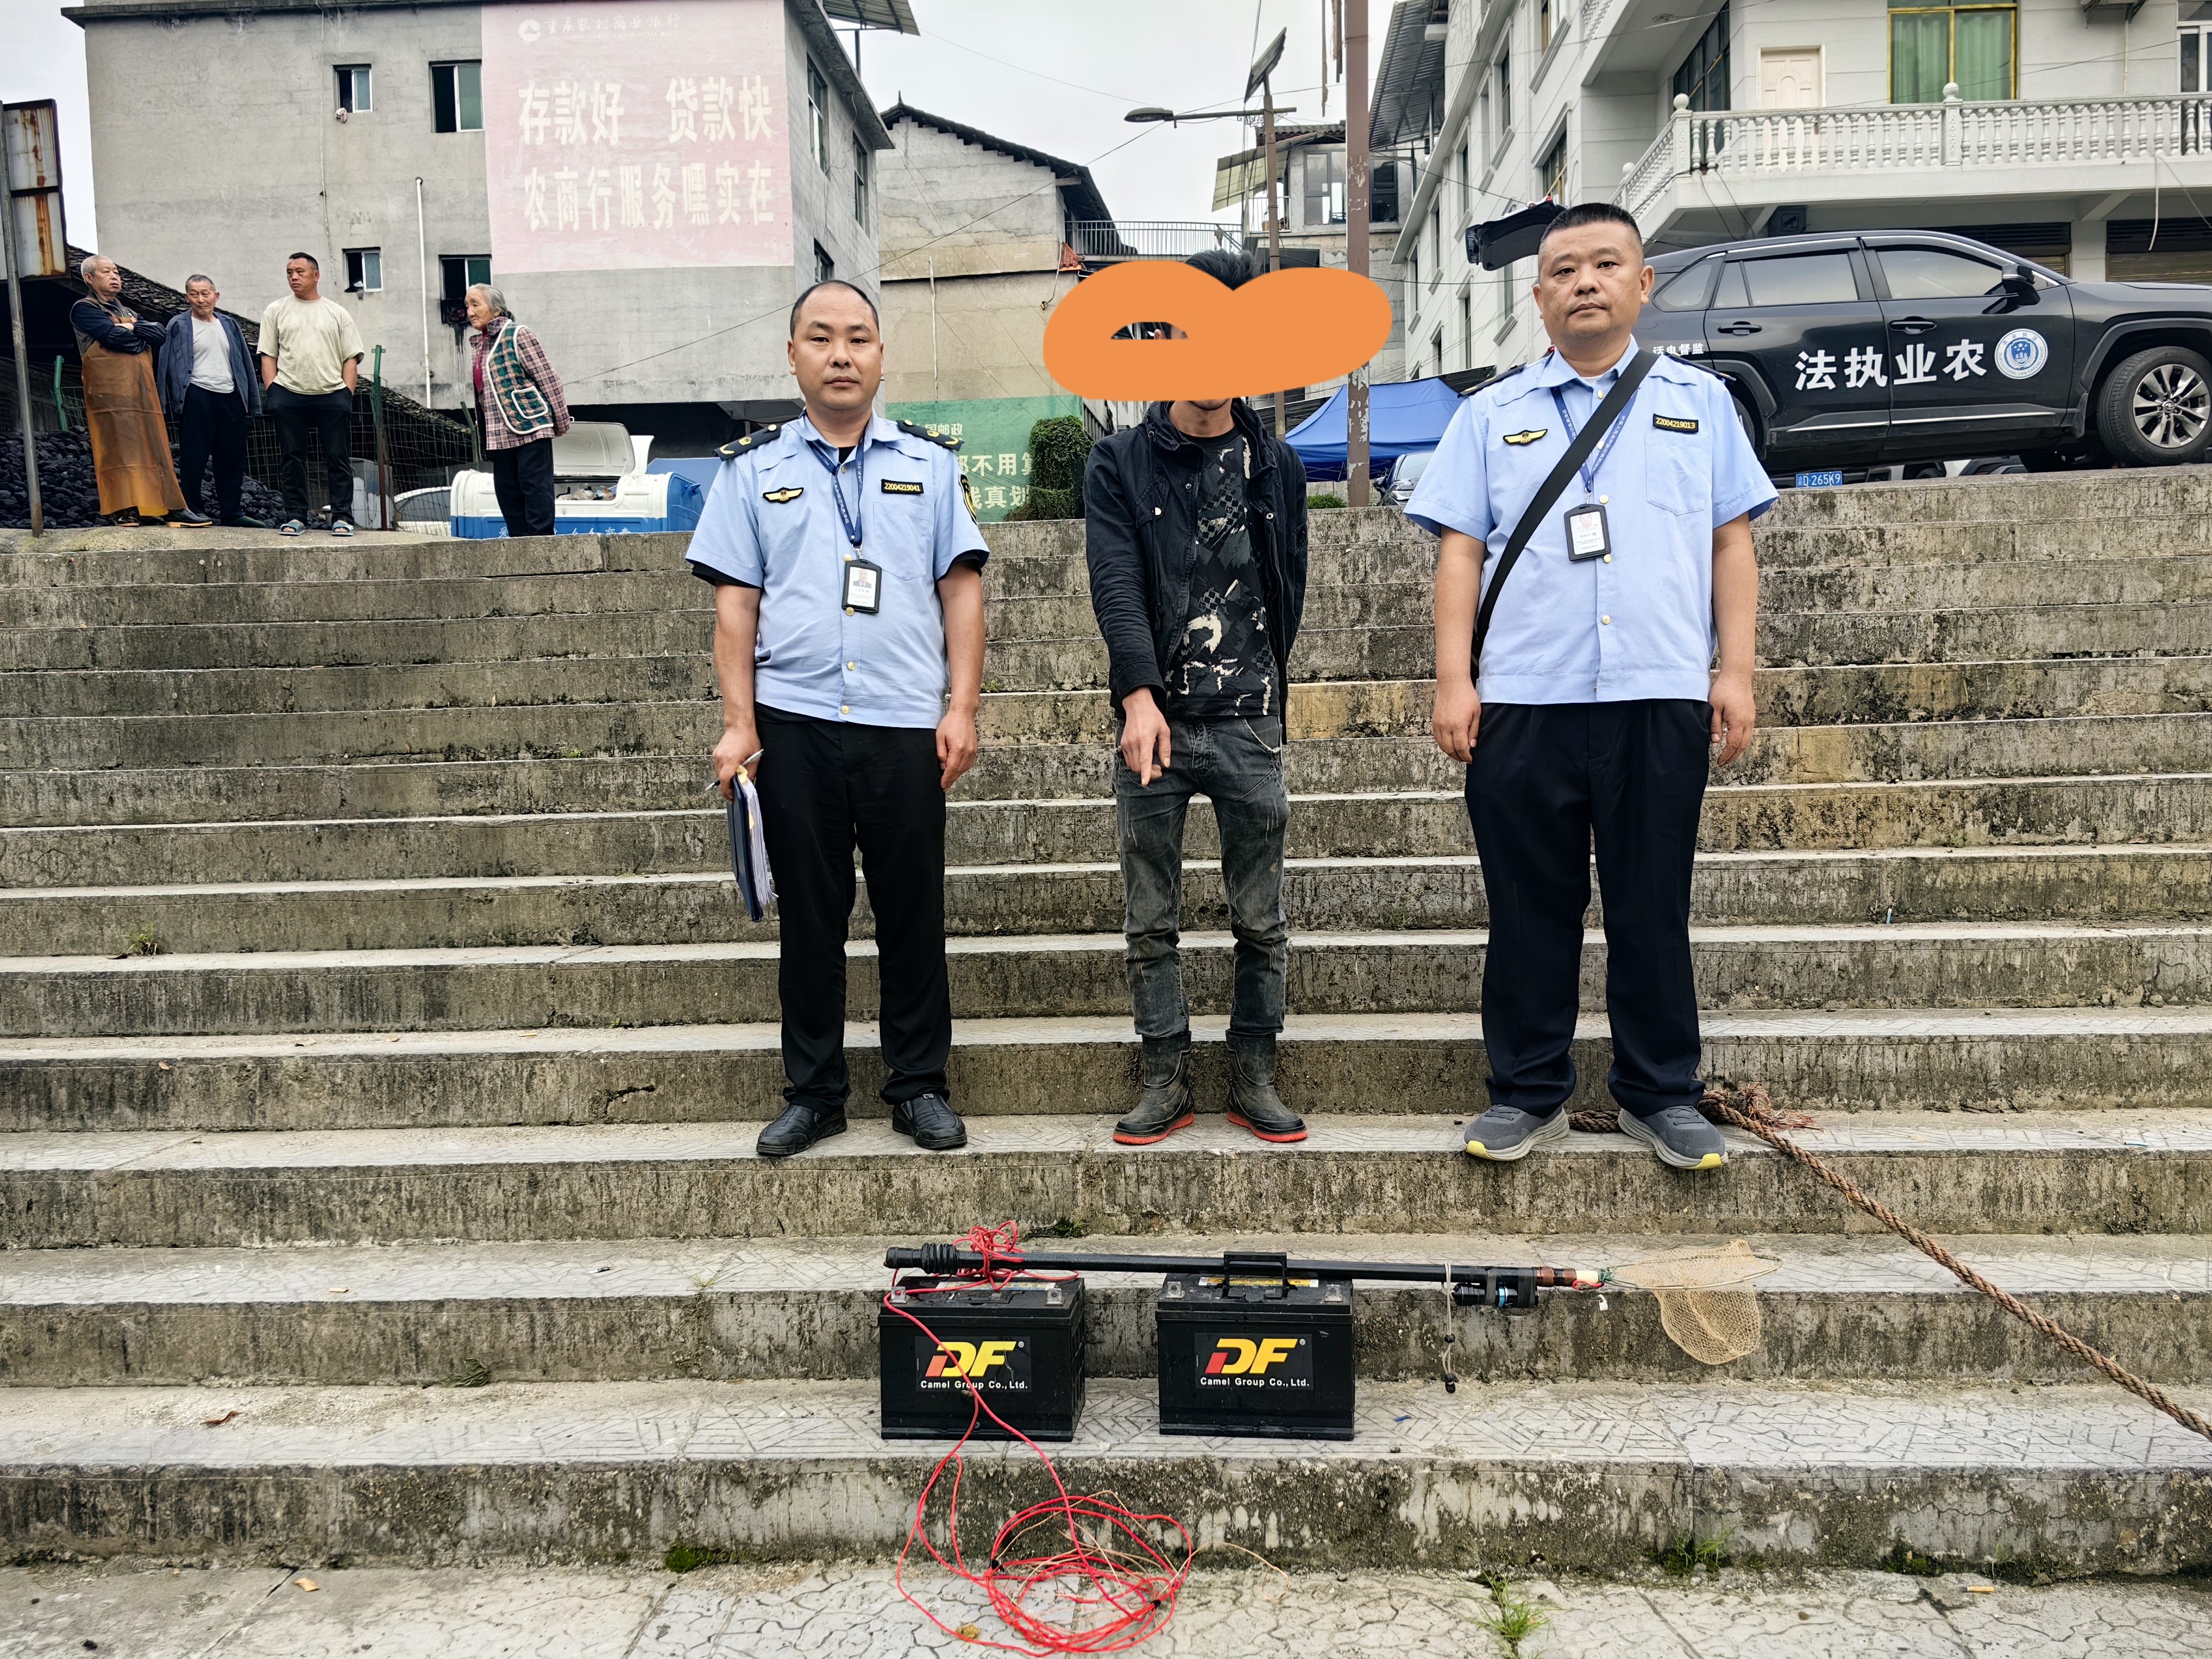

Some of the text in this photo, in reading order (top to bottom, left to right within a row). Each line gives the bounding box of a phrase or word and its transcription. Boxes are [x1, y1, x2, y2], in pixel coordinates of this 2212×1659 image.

[518, 75, 773, 145] 存款好 贷款快
[916, 422, 963, 436] 国邮政
[1656, 417, 1695, 429] 22004219013
[884, 483, 921, 492] 22004219041
[1204, 1338, 1298, 1374] DF
[920, 1380, 950, 1389] Camel
[1200, 1377, 1229, 1385] Camel
[1235, 1378, 1265, 1387] Group
